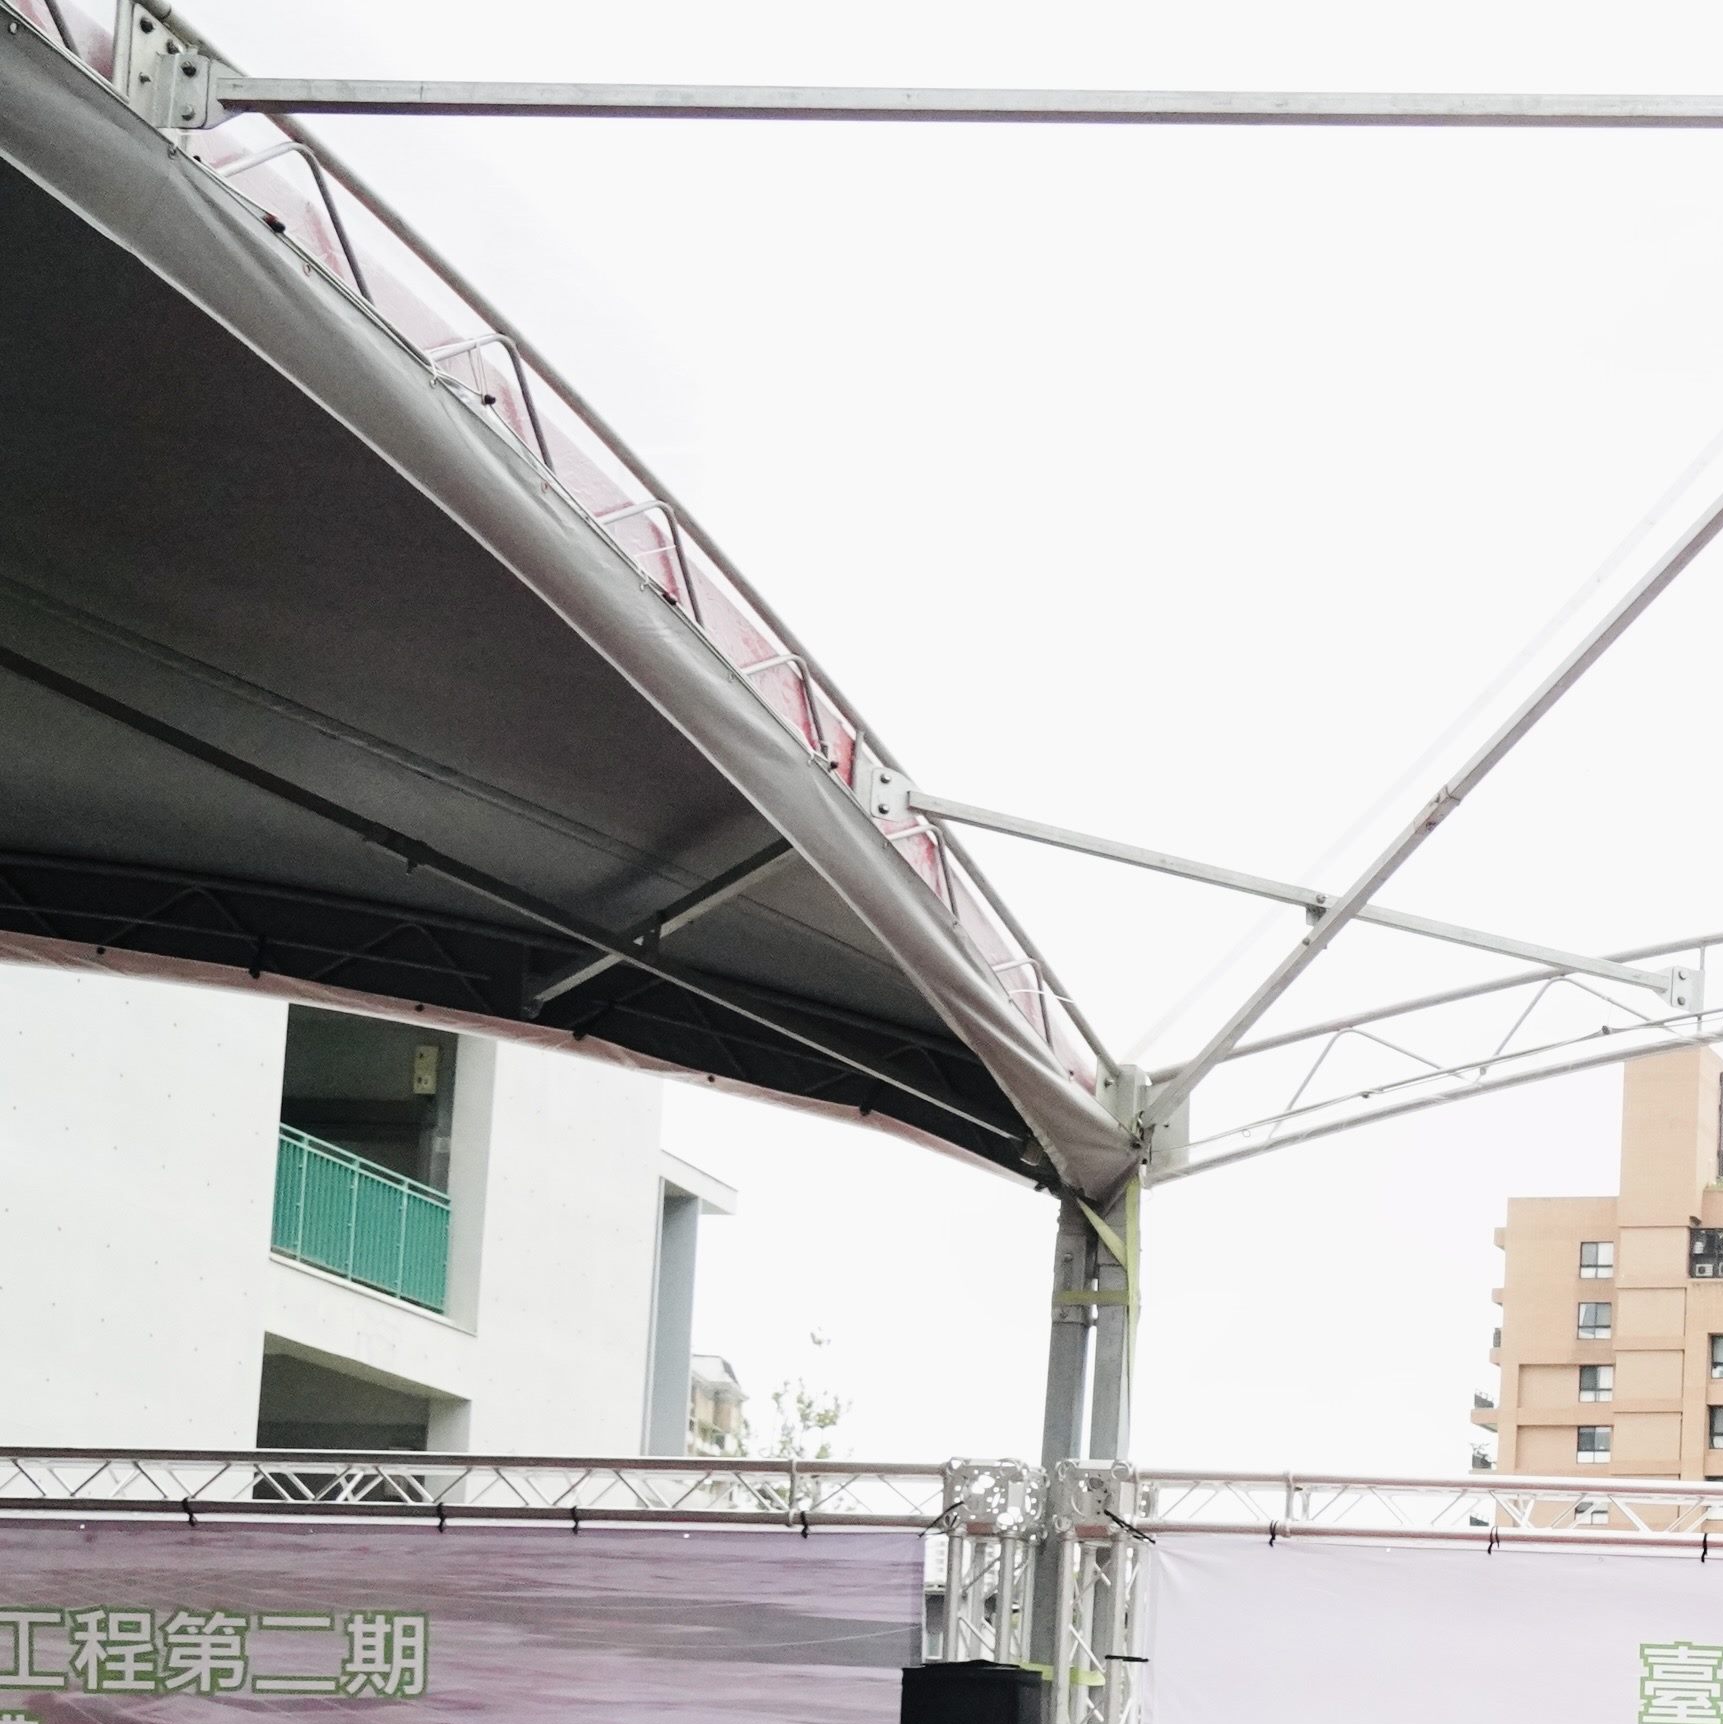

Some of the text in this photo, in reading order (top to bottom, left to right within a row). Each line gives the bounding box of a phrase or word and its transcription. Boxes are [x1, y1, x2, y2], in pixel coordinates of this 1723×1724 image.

[0, 1606, 430, 1697] 工程第二期
